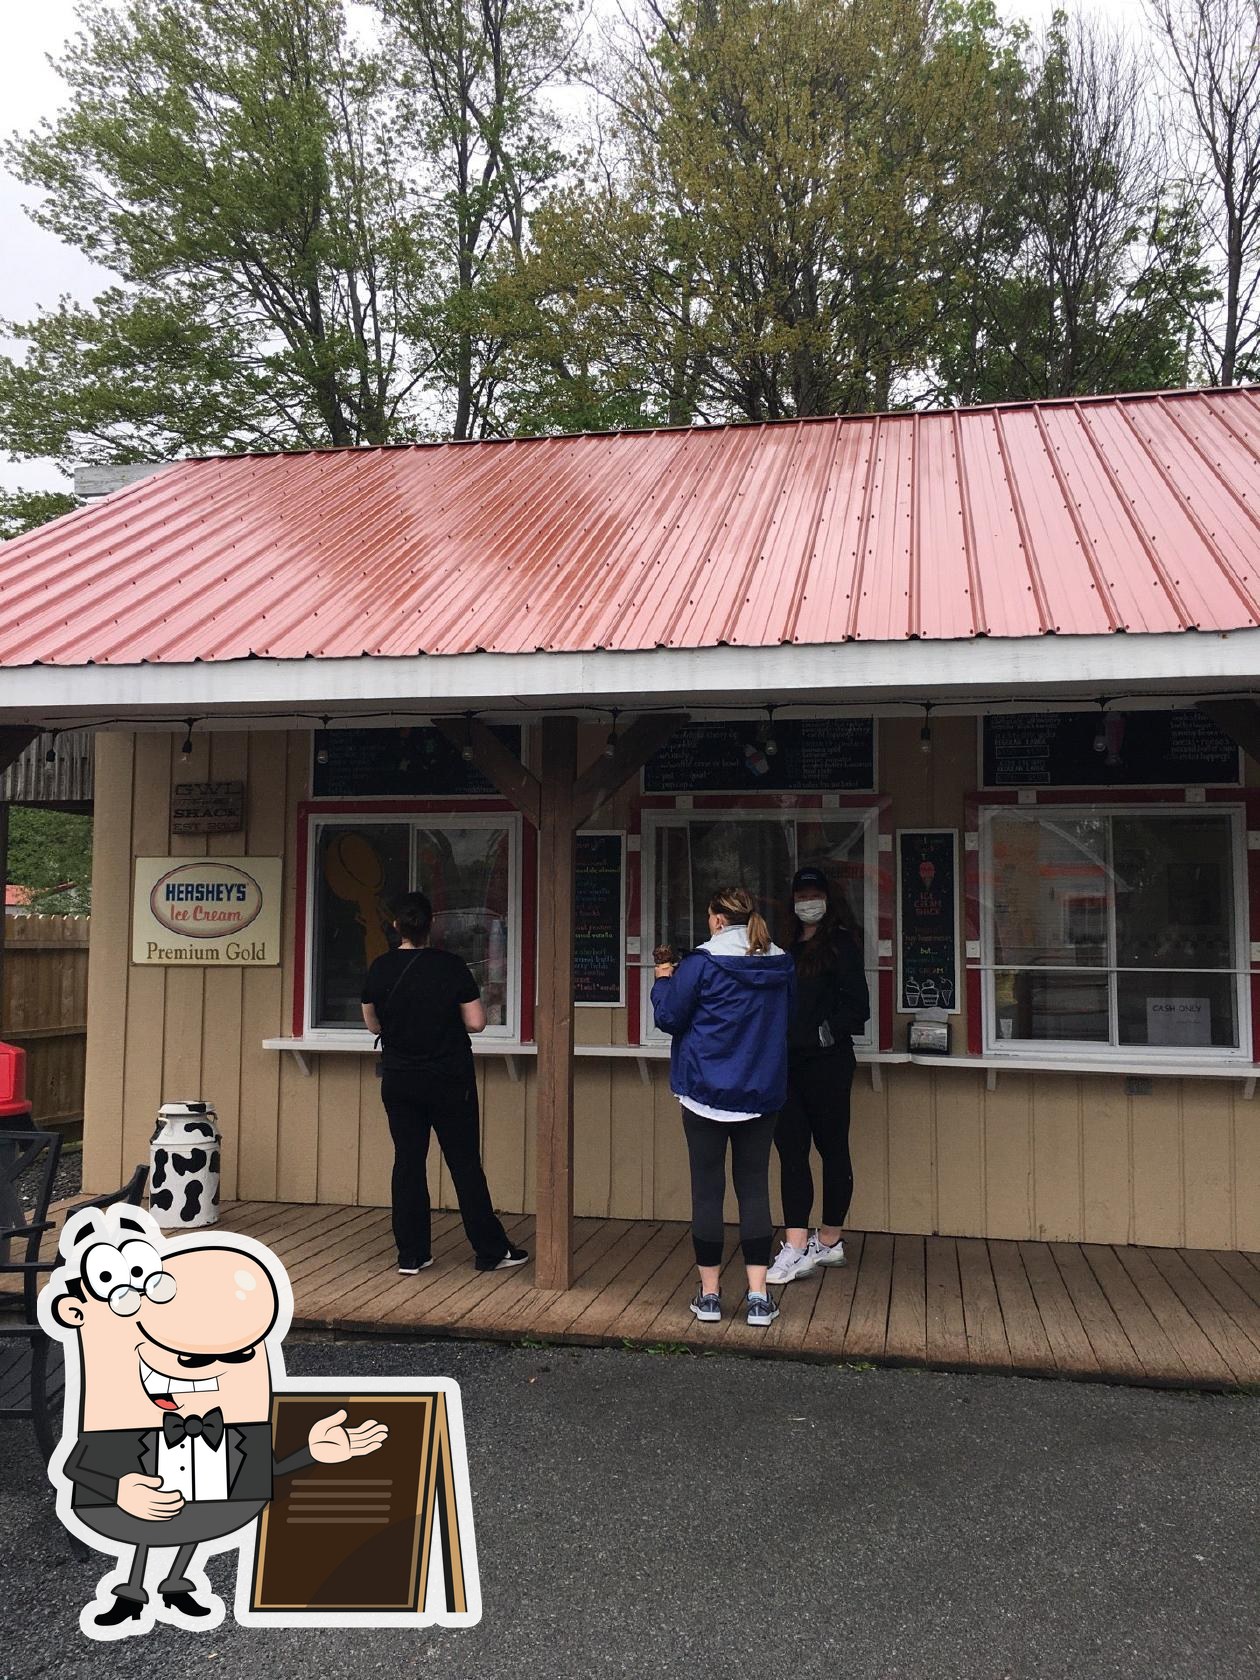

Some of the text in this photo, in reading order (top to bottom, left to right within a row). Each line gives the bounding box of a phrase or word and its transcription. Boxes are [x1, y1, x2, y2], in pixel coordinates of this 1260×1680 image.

[174, 807, 239, 818] SHACK
[165, 883, 247, 902] HERSHEY'S
[170, 904, 243, 921] Ice Cream
[147, 942, 266, 961] Premium Gold
[1152, 1004, 1202, 1012] CASH ONLY
